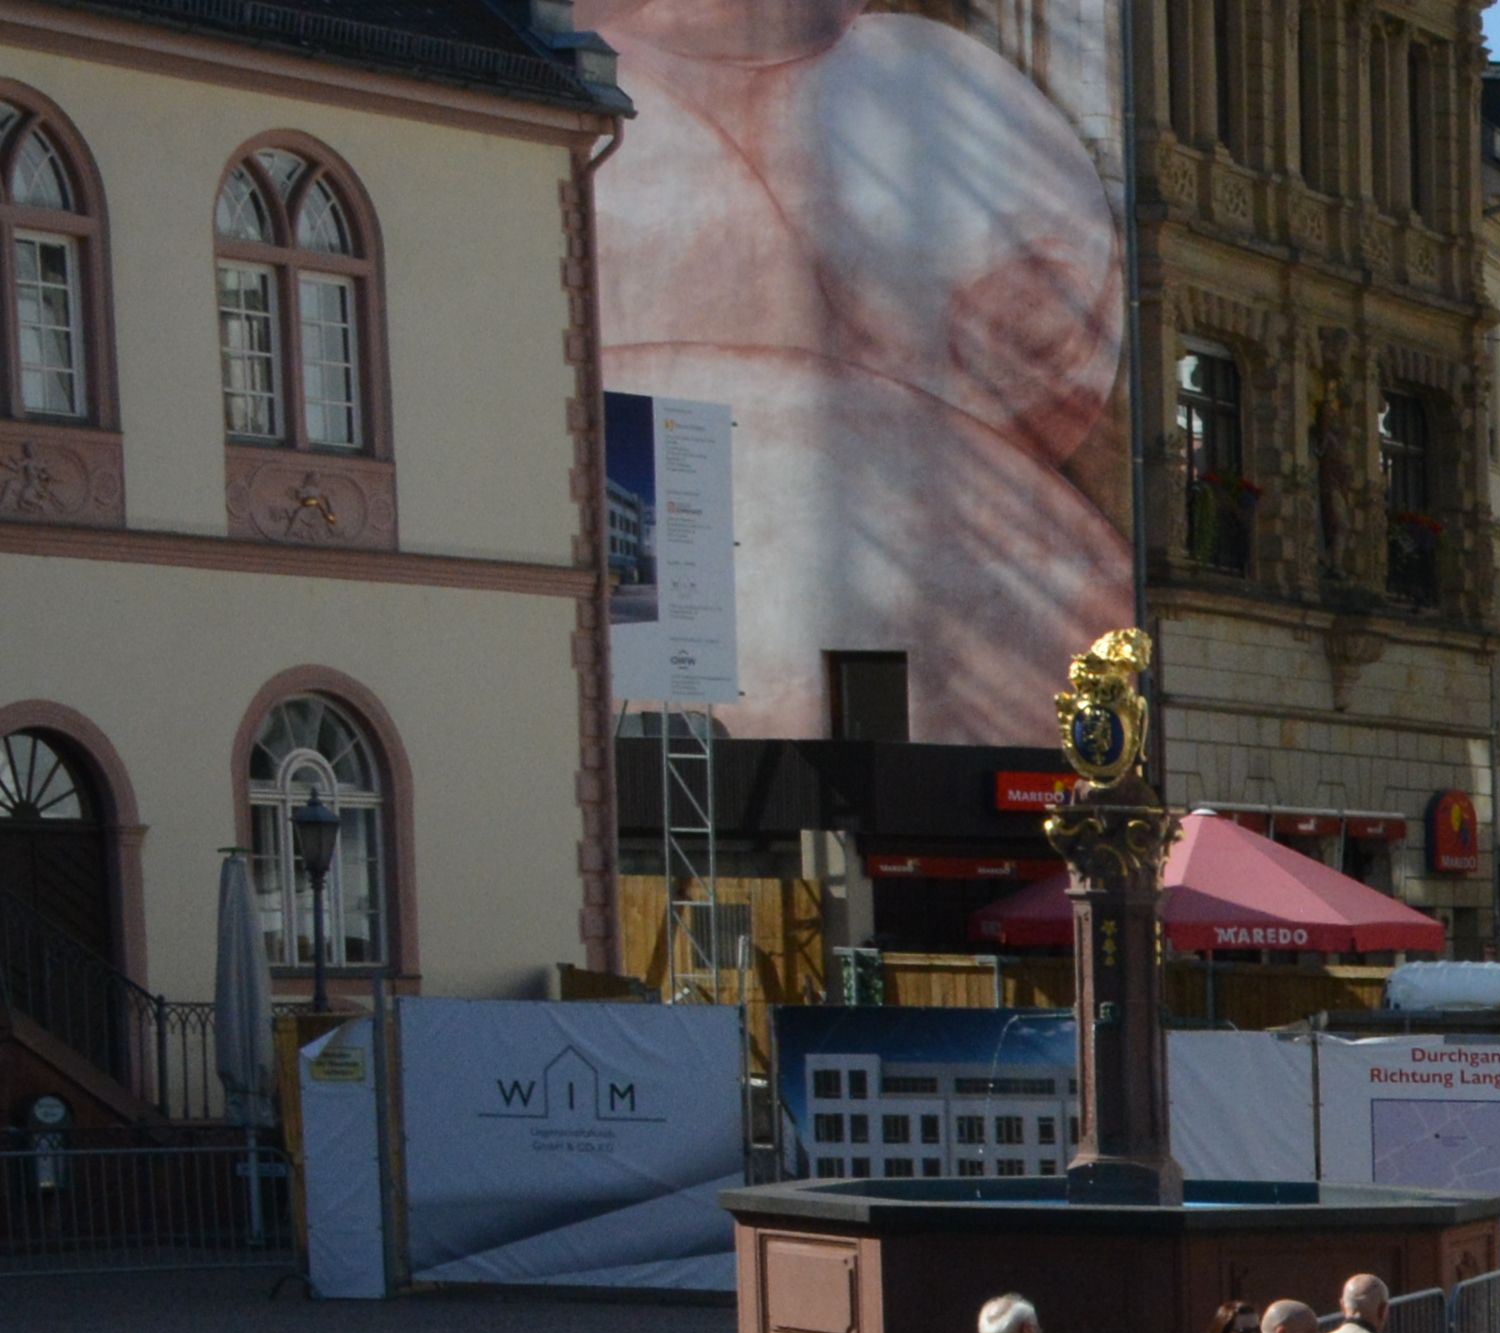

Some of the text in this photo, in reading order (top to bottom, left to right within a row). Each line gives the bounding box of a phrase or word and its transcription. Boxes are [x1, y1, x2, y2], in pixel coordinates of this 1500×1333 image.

[1007, 789, 1065, 803] MAREDO
[1440, 854, 1477, 870] MAREDO
[1214, 925, 1309, 945] MAREDO
[1369, 1068, 1455, 1088] Richtung
